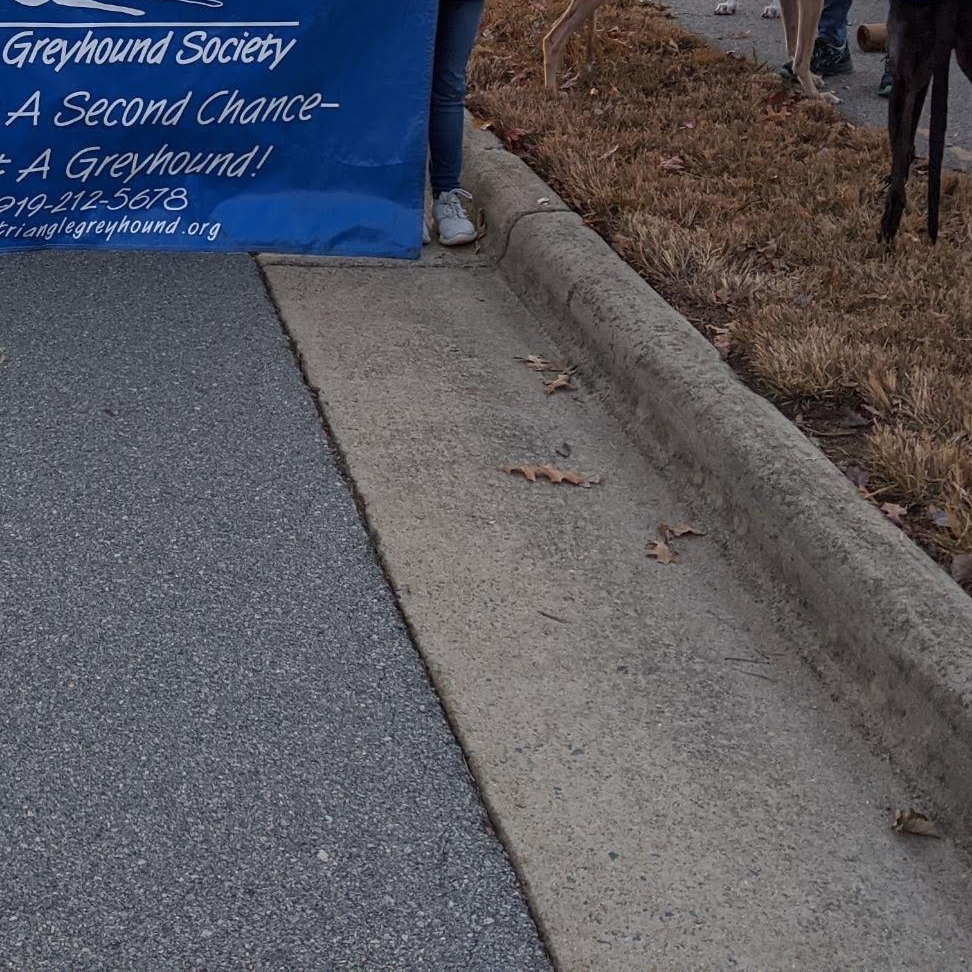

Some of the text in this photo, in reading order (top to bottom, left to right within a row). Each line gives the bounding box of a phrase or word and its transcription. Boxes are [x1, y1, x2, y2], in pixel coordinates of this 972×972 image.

[2, 29, 174, 73] Greyhound
[175, 30, 297, 71] Society
[4, 90, 41, 127] A
[54, 90, 193, 127] Second
[15, 148, 52, 183] A
[65, 144, 273, 186] Greyhound!
